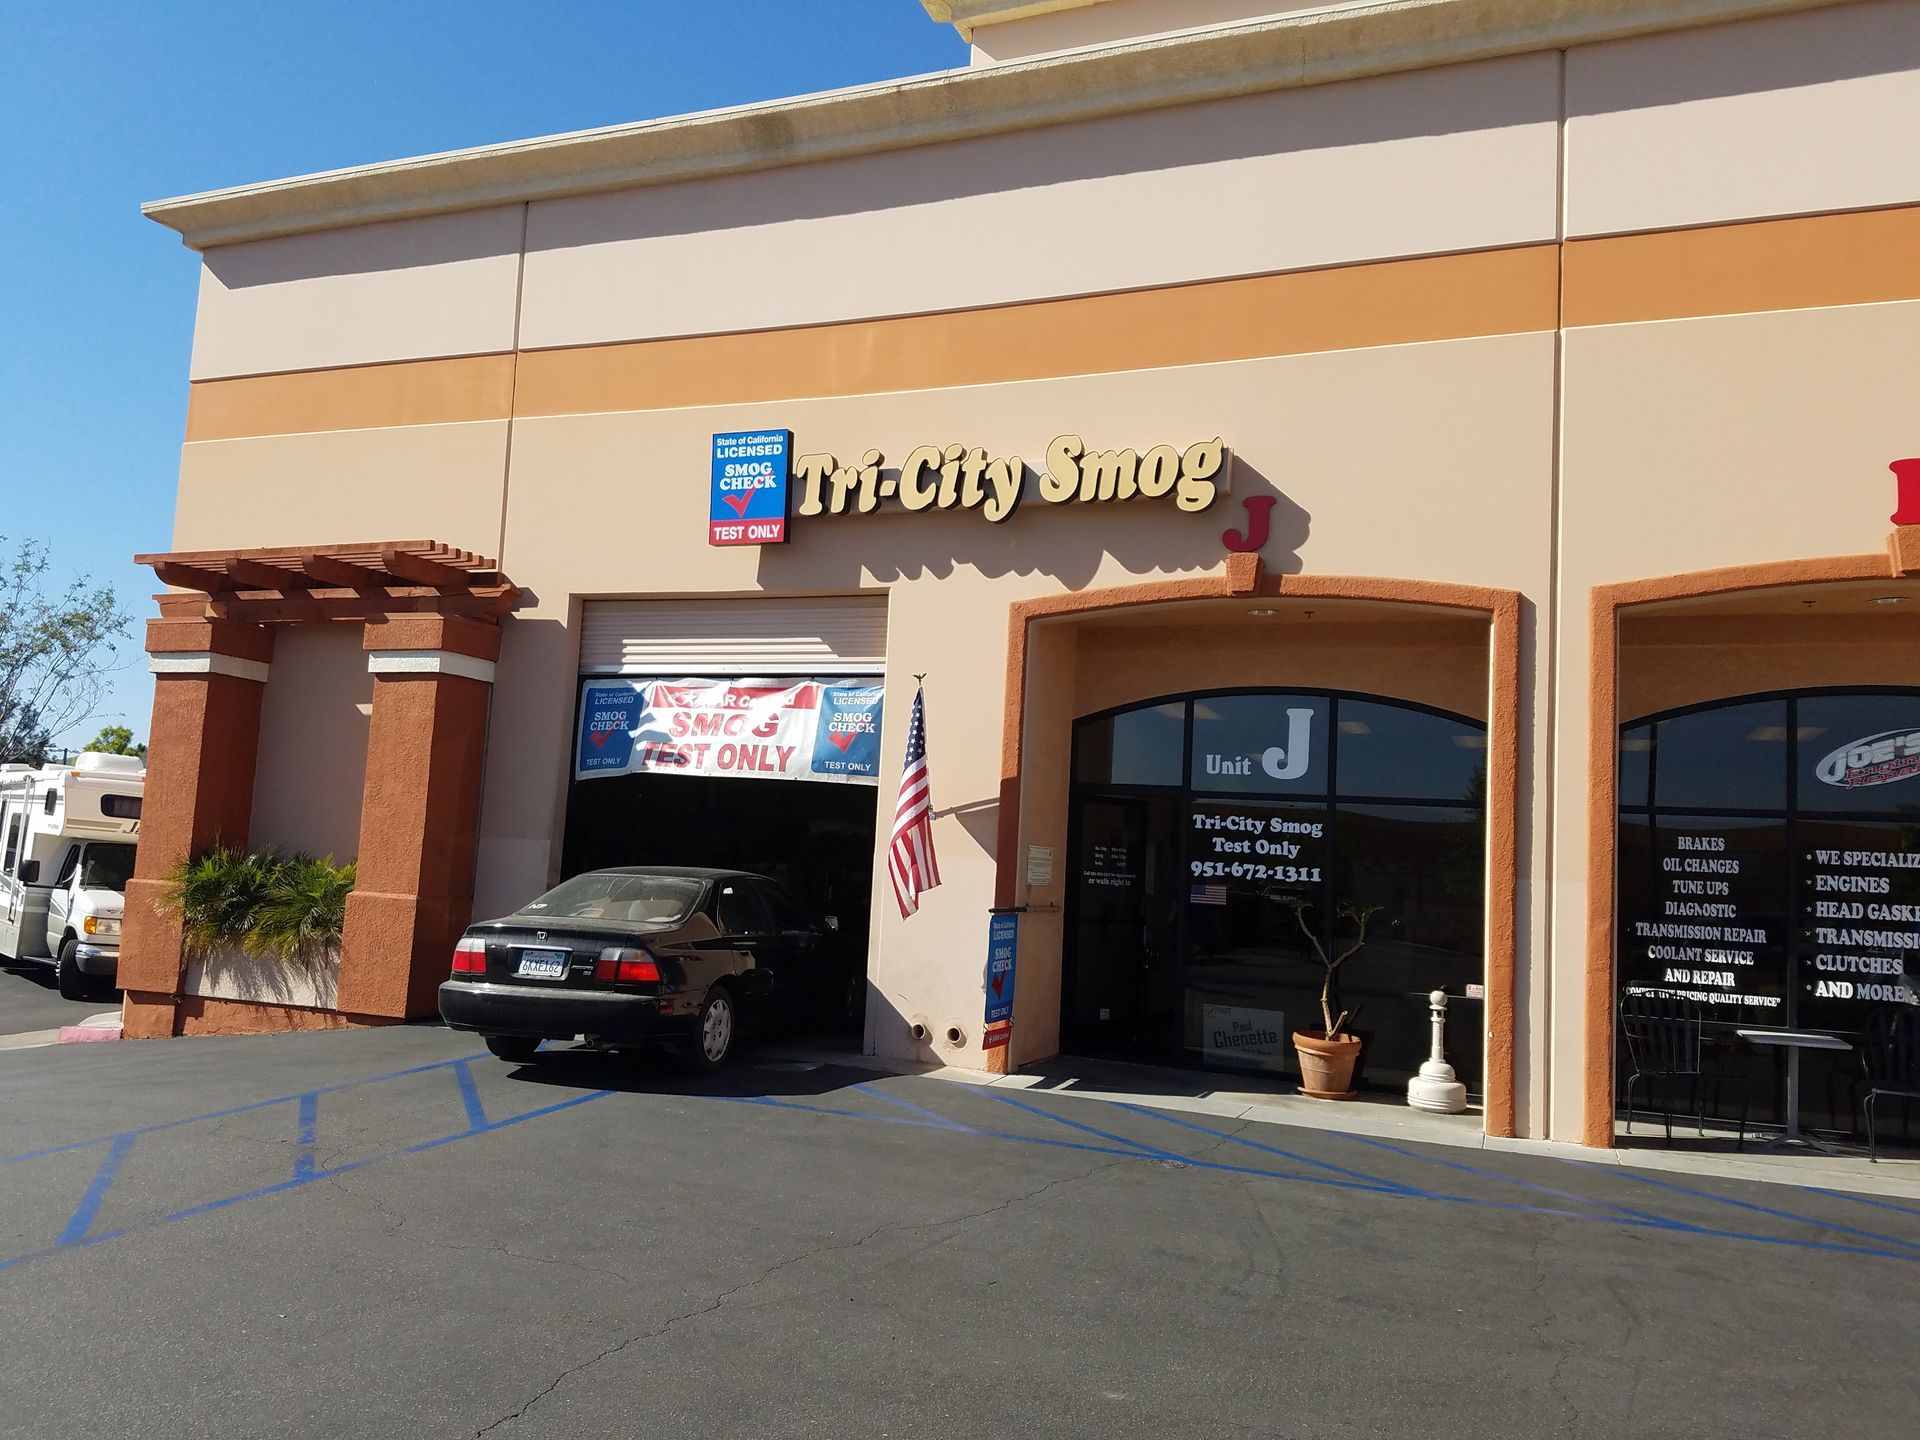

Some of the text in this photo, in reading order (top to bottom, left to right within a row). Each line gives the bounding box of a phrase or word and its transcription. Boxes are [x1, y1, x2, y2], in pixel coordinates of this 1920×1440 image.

[716, 434, 784, 446] State of California
[716, 443, 783, 459] LICENSED
[724, 461, 774, 477] SMOG
[719, 475, 777, 491] CHECK
[796, 433, 1224, 524] Tri-City Smog
[713, 523, 781, 540] TEST ONLY
[1222, 495, 1278, 553] J
[594, 696, 634, 705] LICENSED
[833, 697, 879, 706] LICENSED
[594, 711, 627, 721] SMOG
[833, 712, 873, 723] SMOG
[590, 721, 630, 731] CHECK
[828, 721, 876, 734] CHECK
[1206, 708, 1315, 780] Unit J
[586, 757, 622, 766] TEST ONLY
[642, 741, 797, 773] TEST ONLY
[824, 760, 872, 772] TEST ONLY
[1192, 814, 1324, 838] Tri-City Smog
[1212, 837, 1302, 860] Test Only
[1677, 836, 1726, 851] BRAKES
[1662, 857, 1740, 874] OIL CHANGES
[1815, 850, 1841, 865] WE
[1190, 860, 1323, 883] 951-672-1311
[1672, 879, 1730, 896] TUNE UPS
[1815, 874, 1890, 894] ENGINES
[1665, 901, 1737, 918] DIAGNOSTIC
[1815, 901, 1864, 918] HEAD
[1635, 922, 1767, 943] TRANSMISSION REPAIR
[1815, 927, 1920, 950] TRANSMISSI
[1648, 945, 1755, 966] COOLANT SERVICE
[1815, 954, 1904, 975] CLUTCHES
[1664, 967, 1736, 987] AND REPAIR
[1709, 993, 1743, 1004] QUALITY
[1815, 980, 1905, 1003] AND MORE
[1233, 1020, 1253, 1032] Paul
[1213, 1030, 1278, 1049] Chenette
